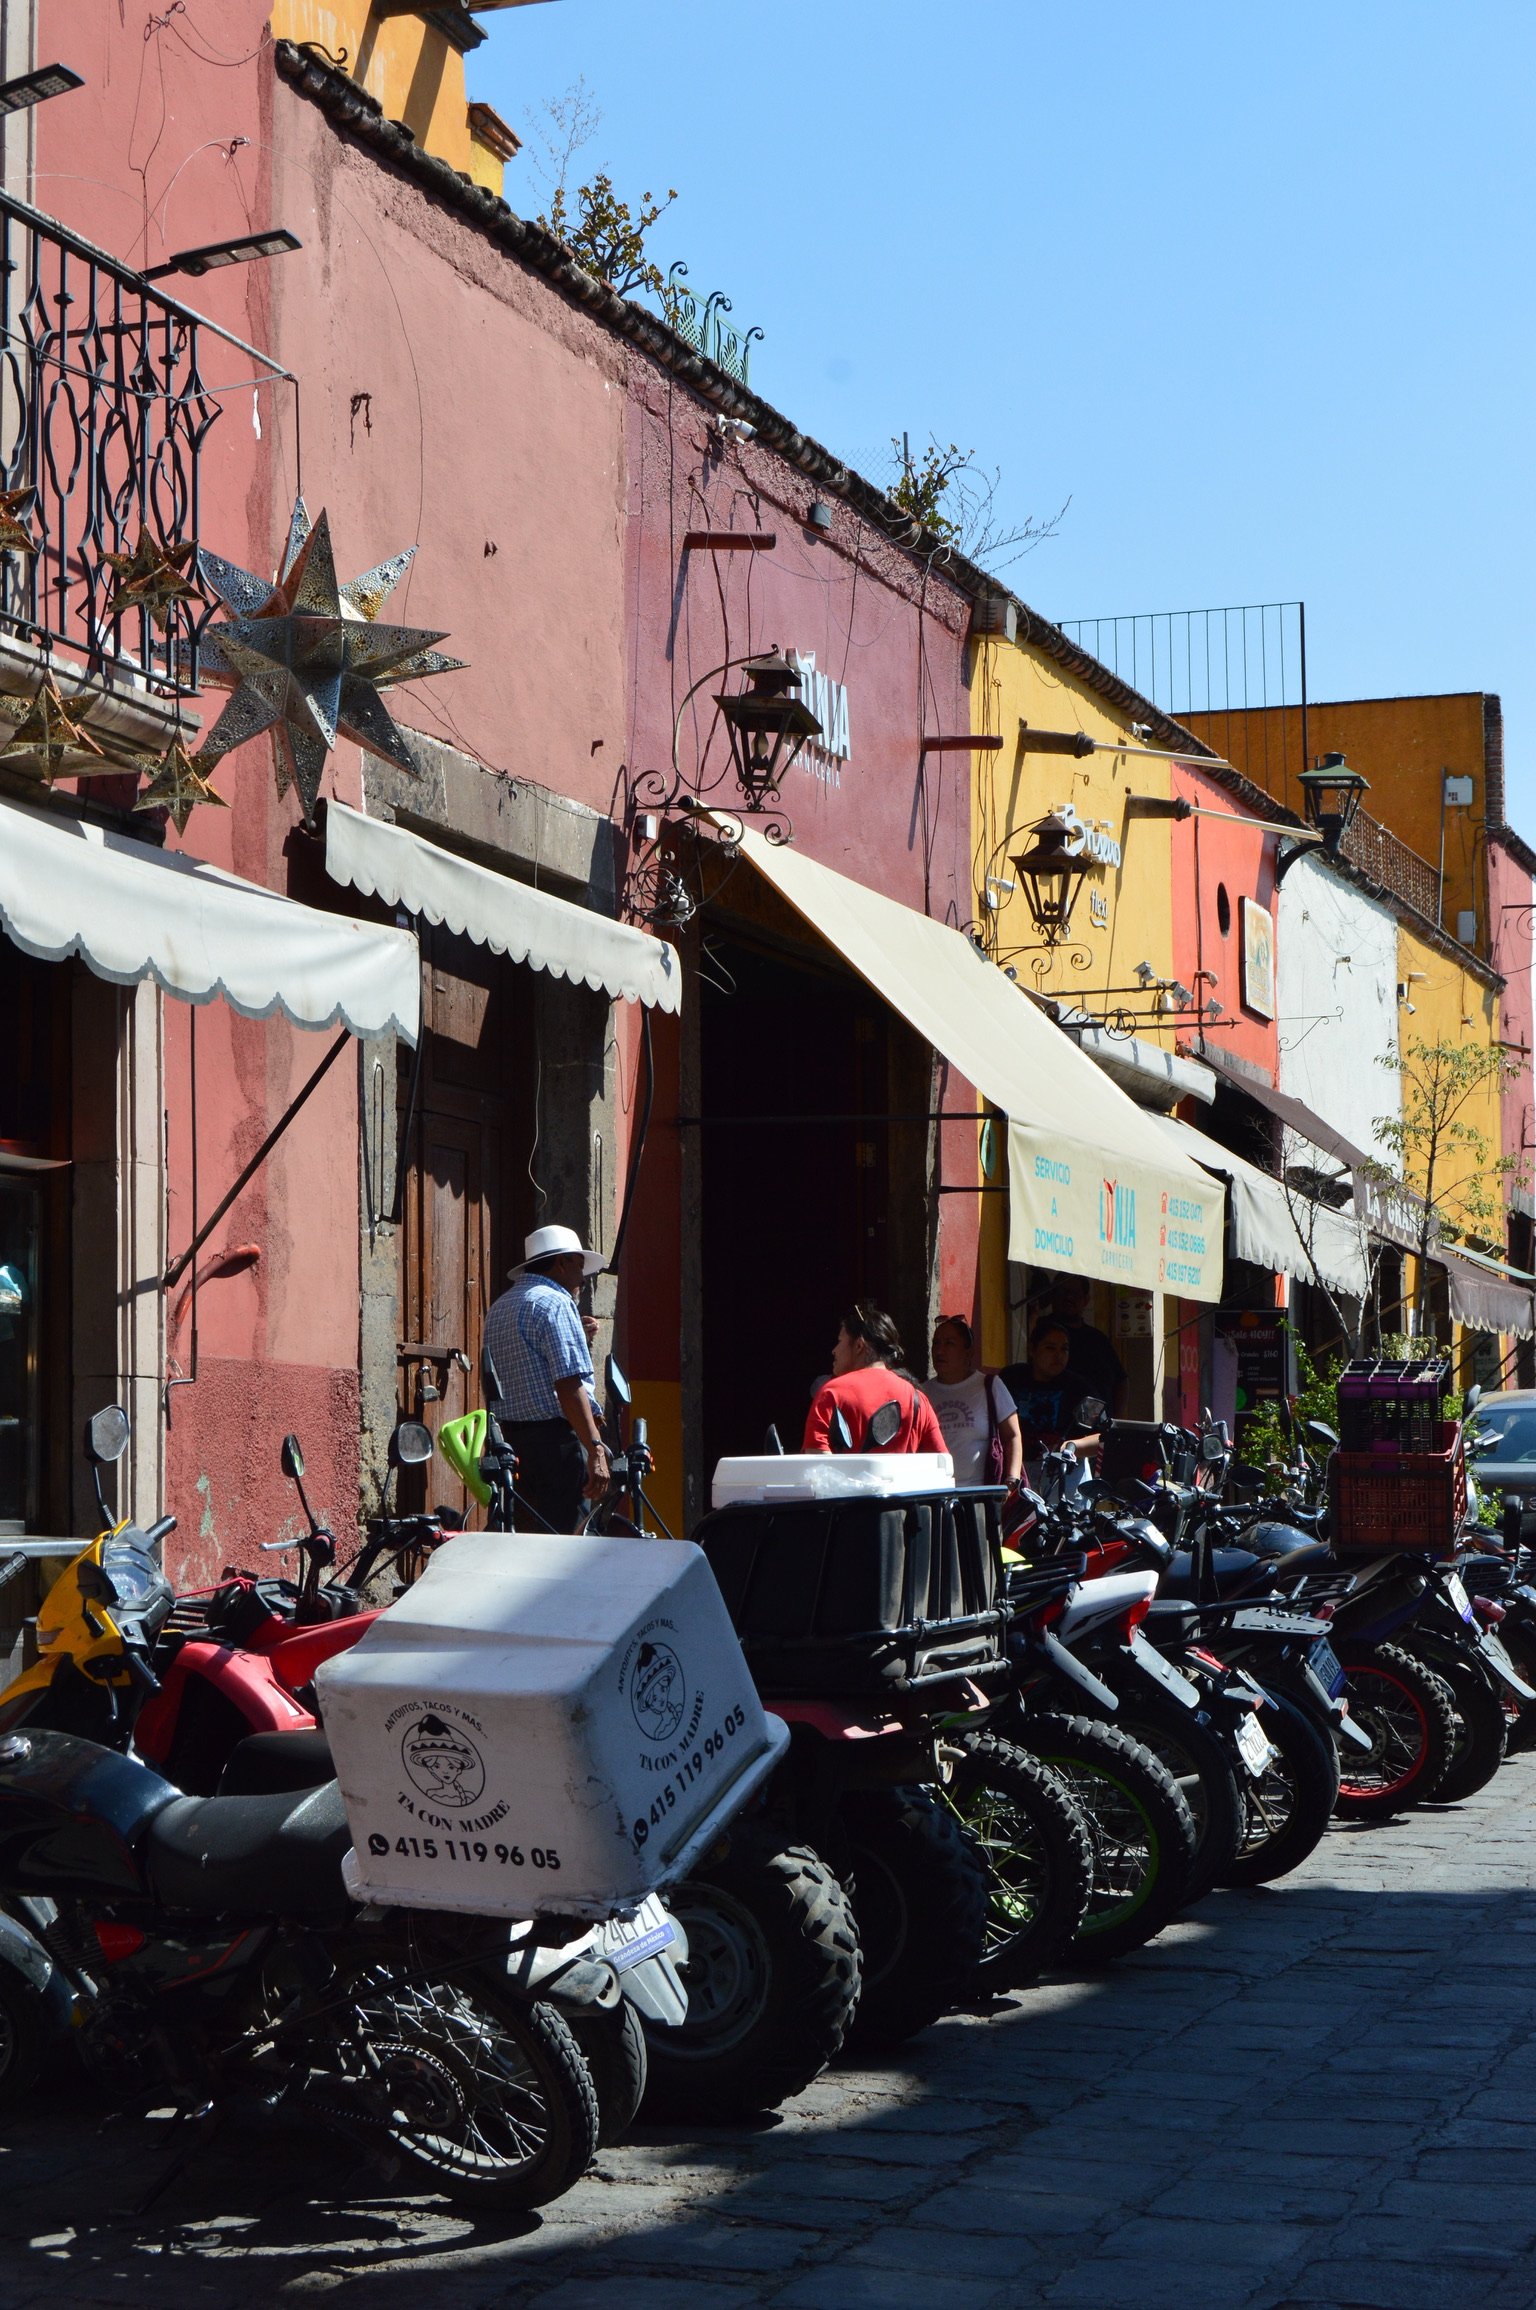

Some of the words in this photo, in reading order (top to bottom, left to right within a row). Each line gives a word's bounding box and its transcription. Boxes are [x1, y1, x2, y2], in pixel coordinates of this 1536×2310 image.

[1034, 1155, 1071, 1185] SERVICIO
[1051, 1197, 1058, 1217] A
[1365, 1183, 1381, 1219] LA
[1034, 1228, 1074, 1257] DOMICILIO
[424, 1701, 452, 1713] TACOS
[678, 1689, 705, 1756] MADRE
[650, 1784, 676, 1826] 415
[675, 1751, 703, 1792] 119
[703, 1728, 724, 1760] 96
[724, 1703, 746, 1737] 05
[397, 1791, 415, 1815] TA
[418, 1810, 452, 1831] CON
[458, 1799, 511, 1833] MADRE
[395, 1836, 438, 1859] 415
[445, 1839, 488, 1863] 119
[494, 1843, 525, 1867] 96
[530, 1847, 561, 1870] 05
[613, 1943, 641, 1964] Grandeza
